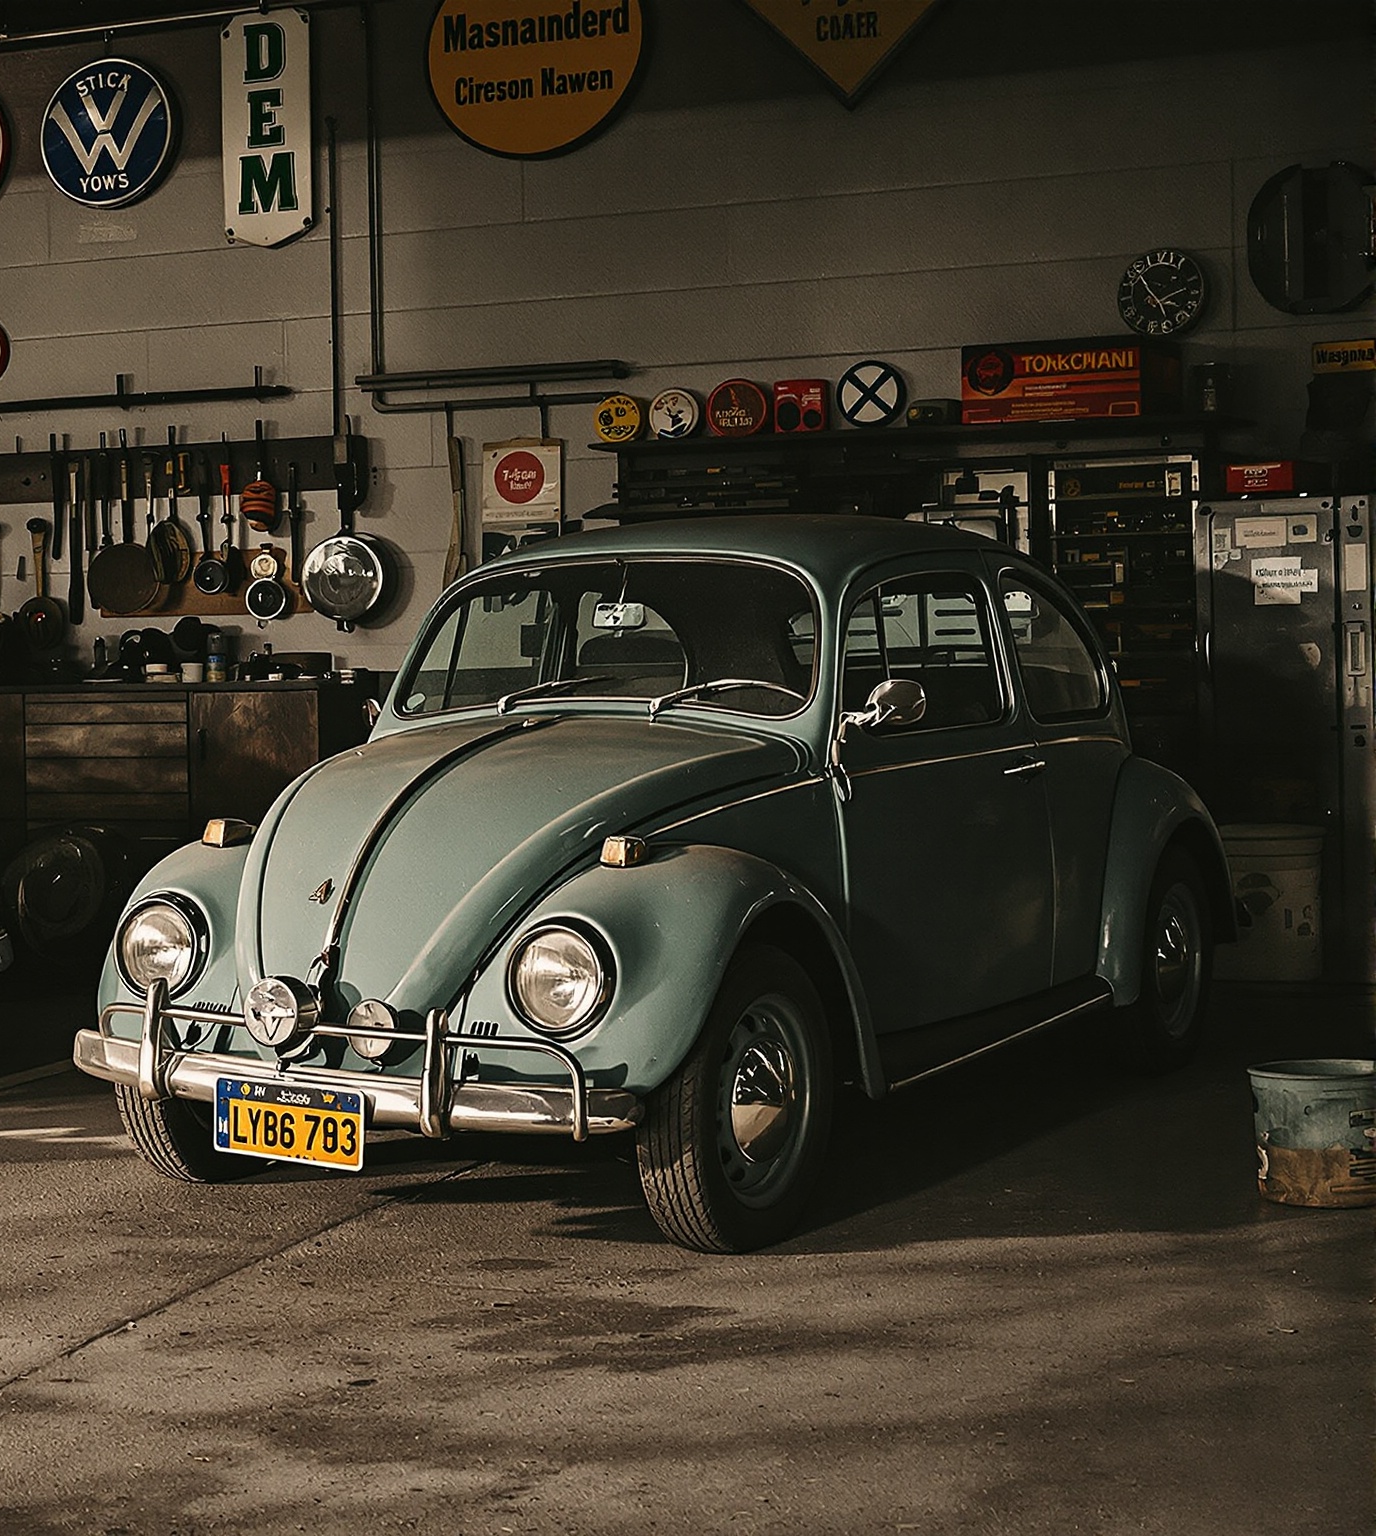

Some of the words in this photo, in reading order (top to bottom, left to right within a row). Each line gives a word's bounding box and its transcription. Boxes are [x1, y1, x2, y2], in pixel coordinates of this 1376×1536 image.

[454, 77, 534, 106] Cireson
[541, 67, 613, 97] Nawen
[239, 22, 299, 215] DEM
[79, 172, 130, 194] YOWS
